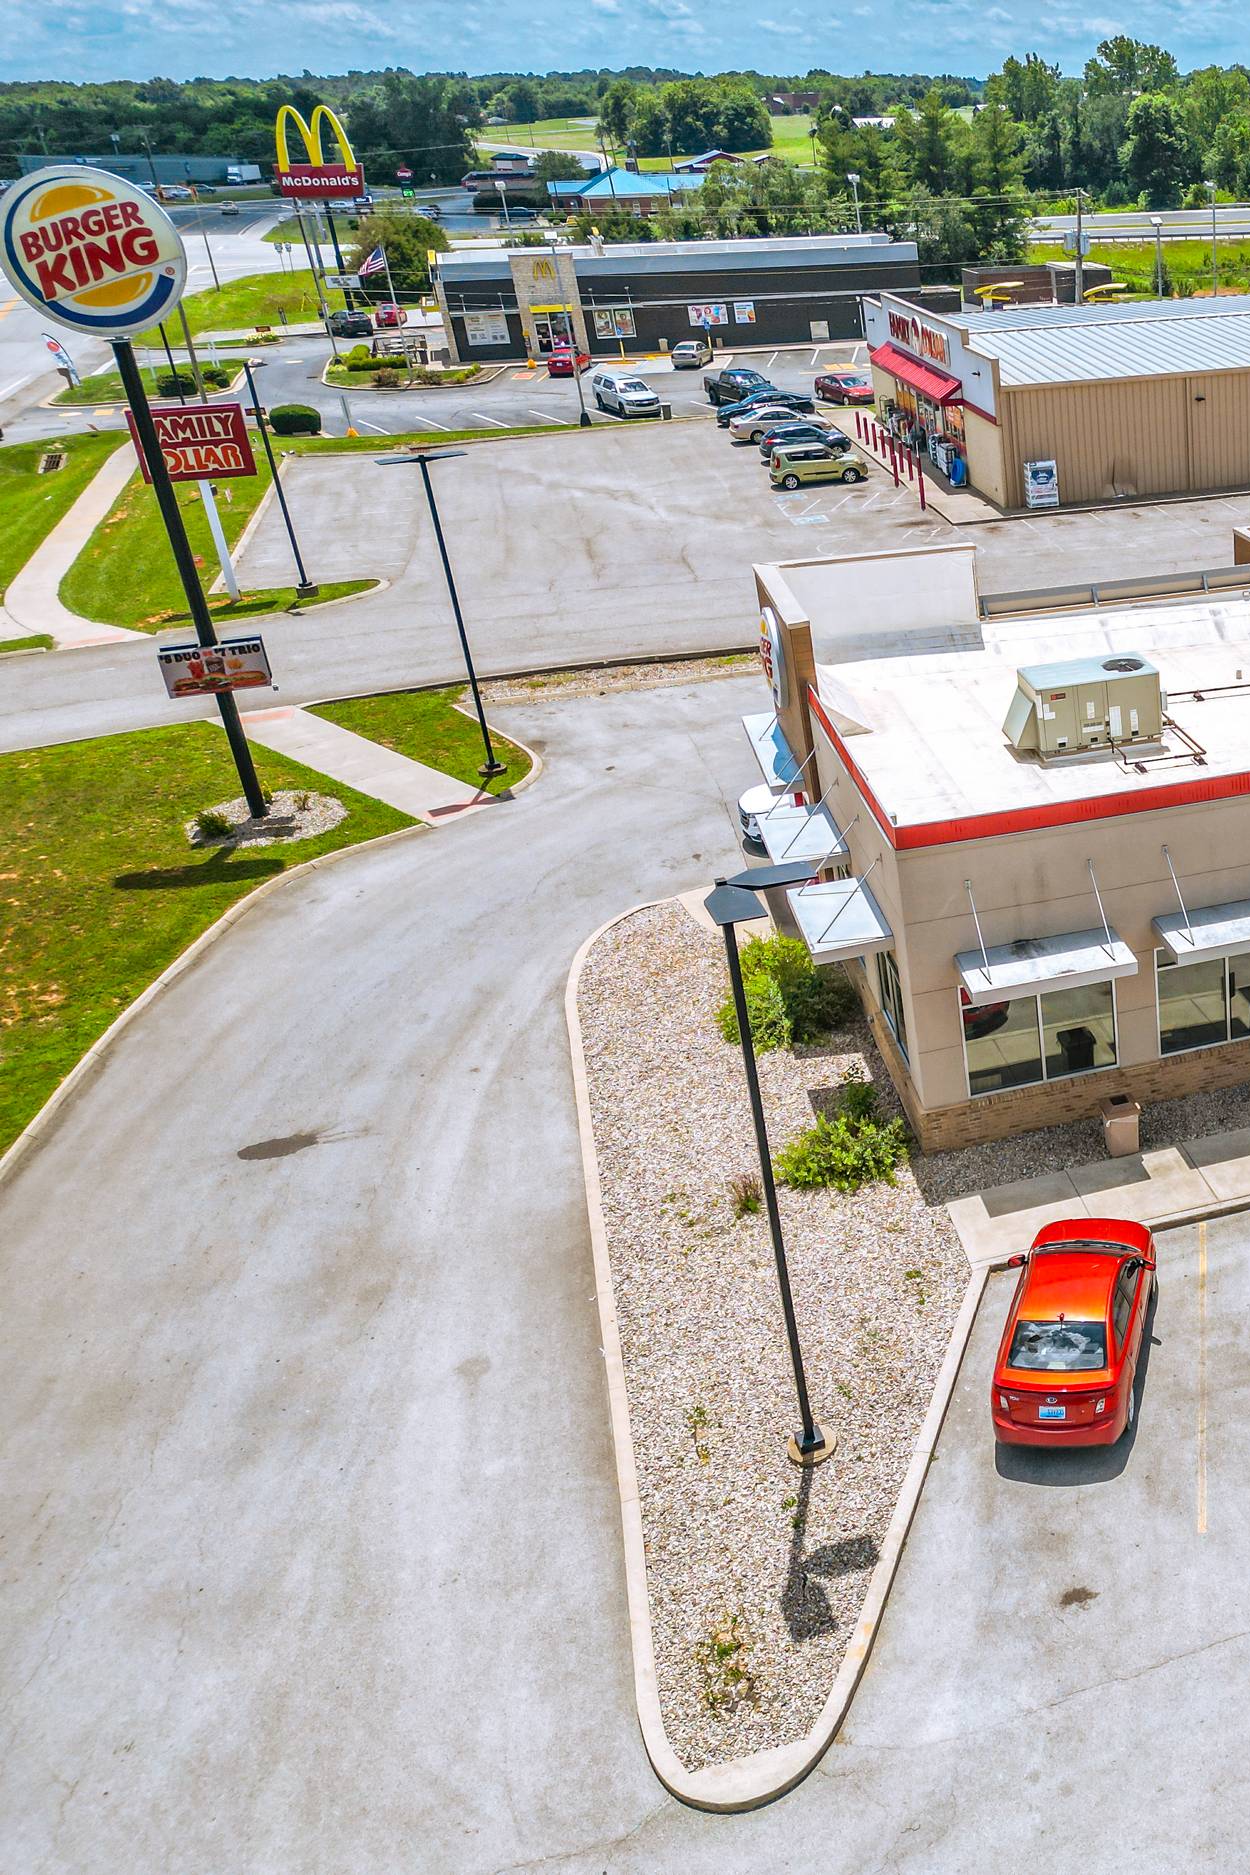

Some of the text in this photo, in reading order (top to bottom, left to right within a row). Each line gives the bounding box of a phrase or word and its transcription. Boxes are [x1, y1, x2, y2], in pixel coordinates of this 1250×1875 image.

[282, 175, 359, 187] McDonald's
[20, 201, 145, 263] BURGER
[35, 227, 160, 300] KING
[153, 412, 234, 442] AMILY
[162, 443, 244, 475] OLLAR
[175, 651, 200, 662] DUO
[229, 643, 260, 655] TRIO
